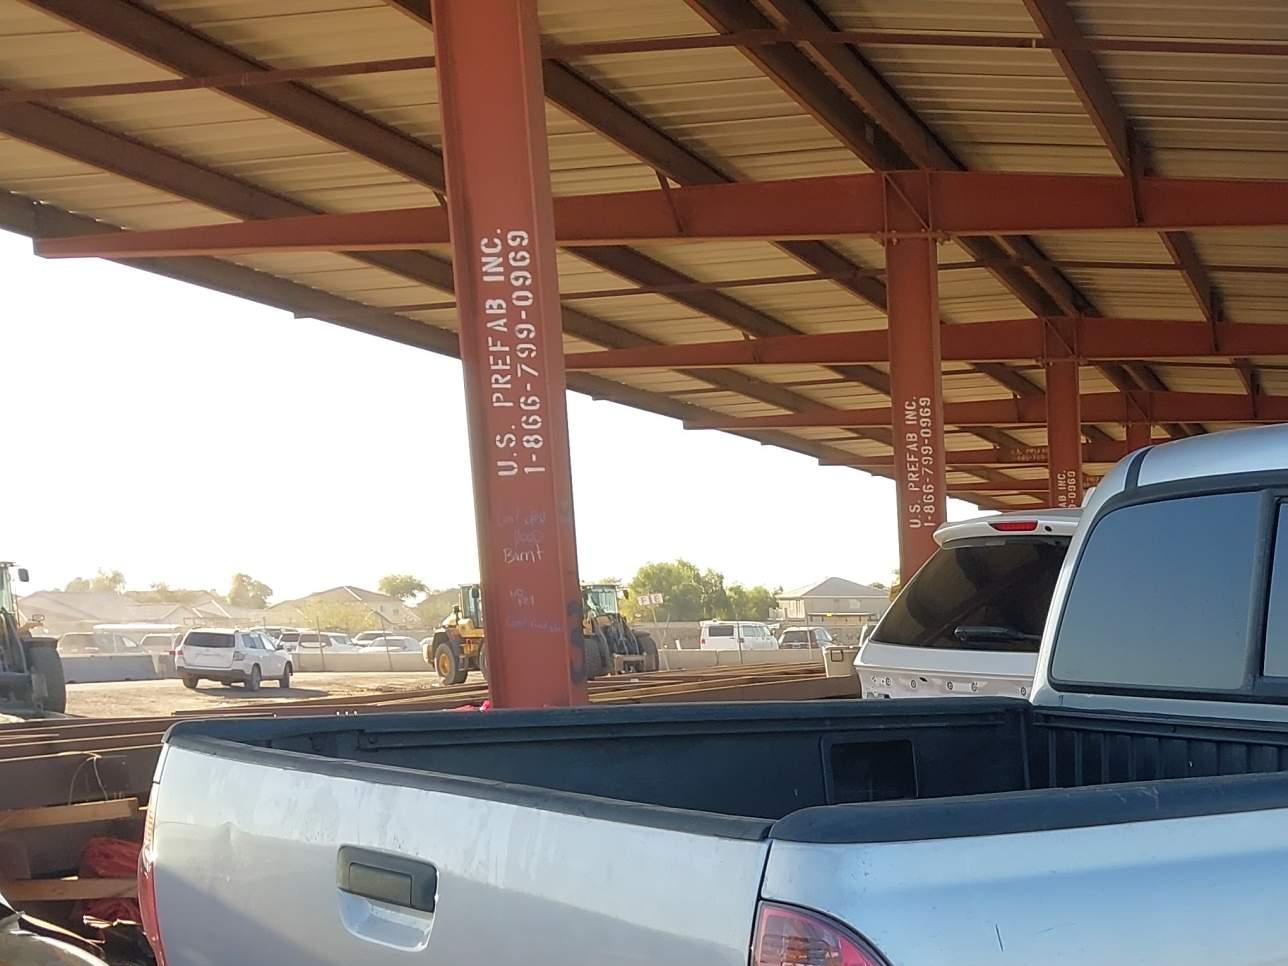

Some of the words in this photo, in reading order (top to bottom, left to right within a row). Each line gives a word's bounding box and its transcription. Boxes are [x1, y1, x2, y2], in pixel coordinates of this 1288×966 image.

[480, 228, 505, 283] INC.
[485, 296, 514, 408] PREFAB
[507, 229, 546, 474] 1-866-799-0969
[904, 395, 918, 426] INC.
[495, 423, 519, 477] U.S.
[905, 432, 920, 492] PREFAB
[919, 397, 936, 526] 1-866-799-0969
[909, 500, 921, 528] U.S.
